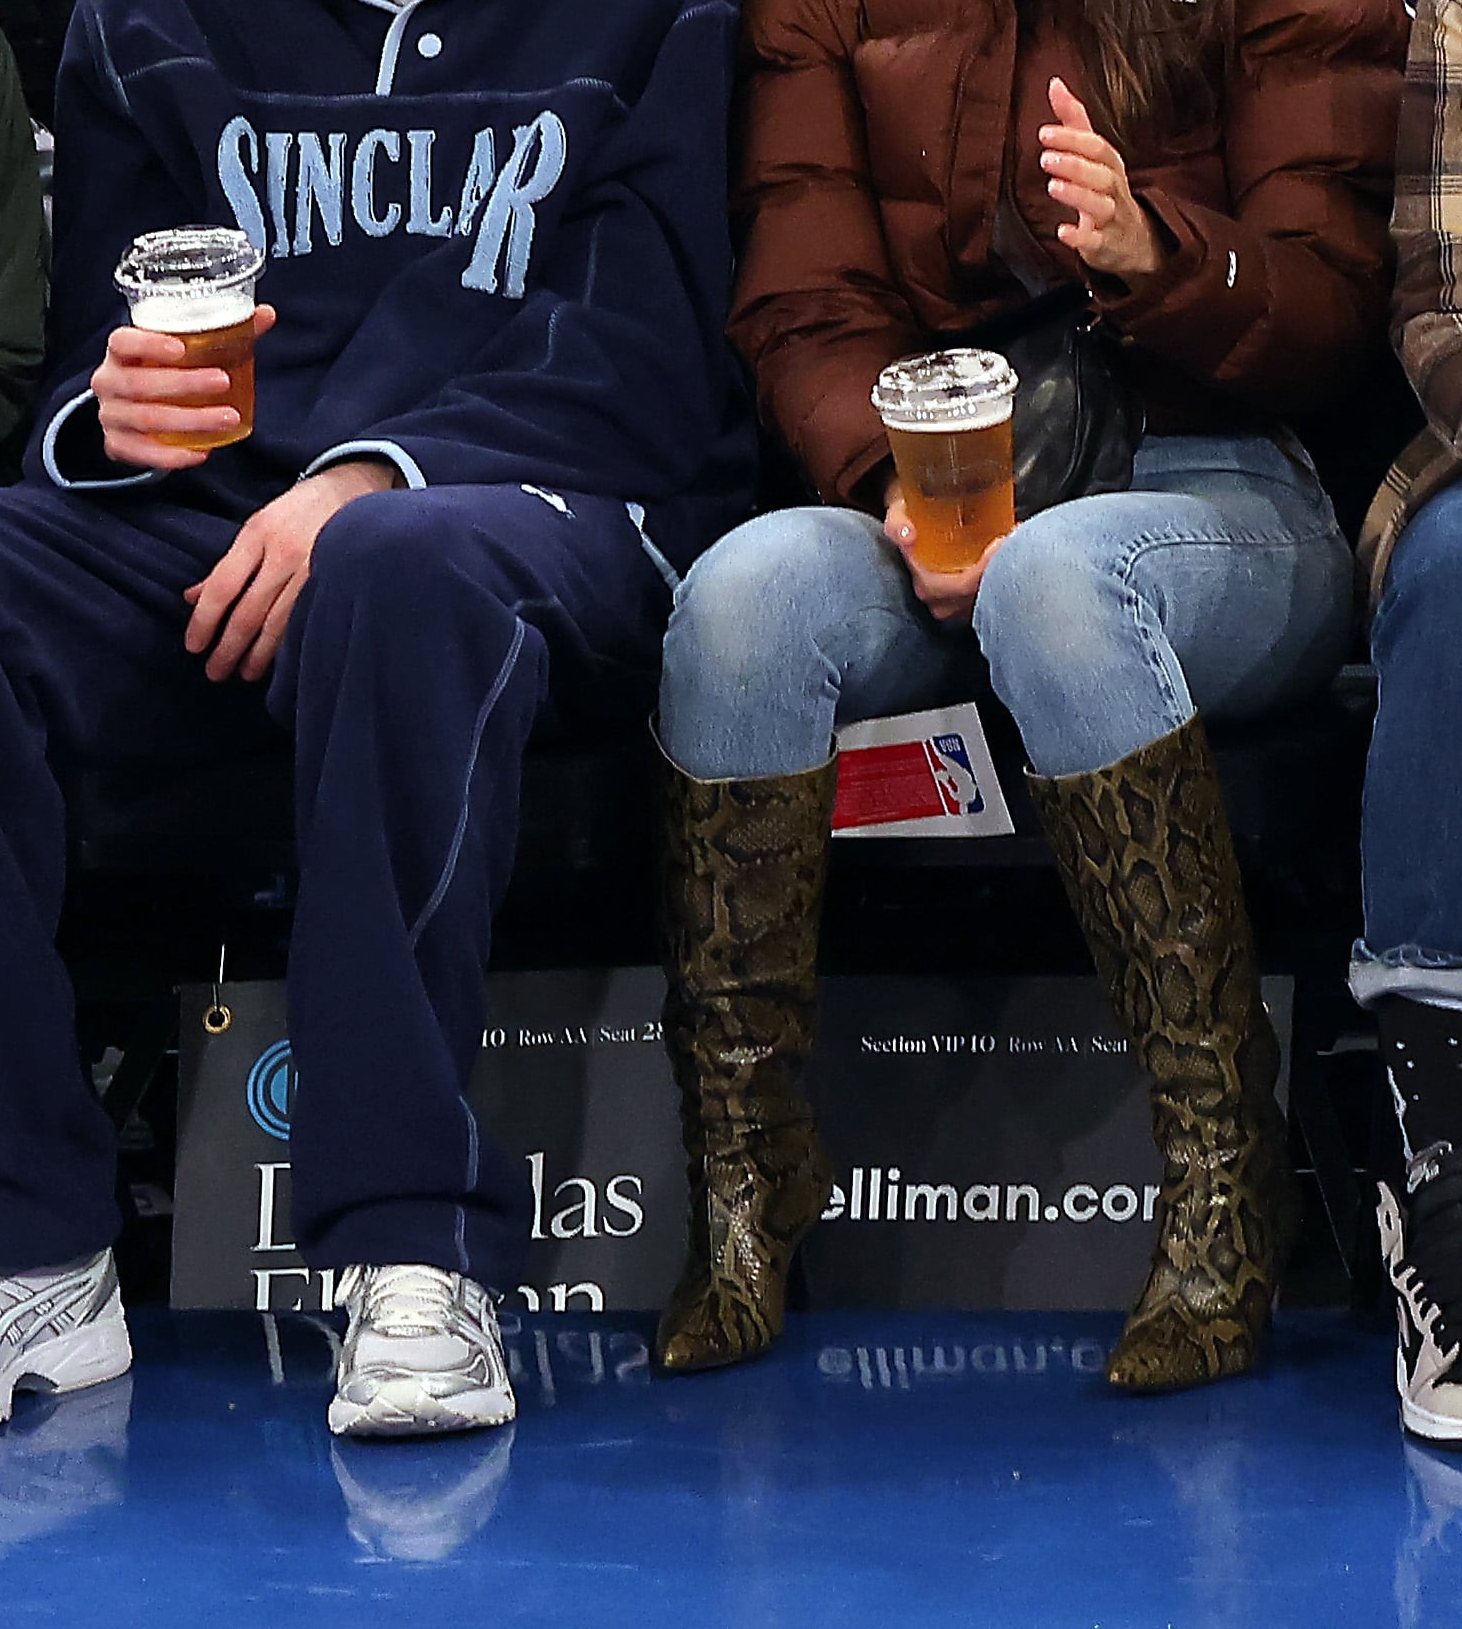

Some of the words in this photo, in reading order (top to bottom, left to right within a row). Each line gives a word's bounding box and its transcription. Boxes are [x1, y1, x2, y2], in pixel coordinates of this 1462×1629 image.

[519, 1029, 555, 1046] Row
[600, 1026, 636, 1043] Seat
[861, 1035, 927, 1053] Section
[931, 1035, 965, 1053] VIP
[1009, 1037, 1045, 1053] Row
[1091, 1036, 1129, 1053] Seat
